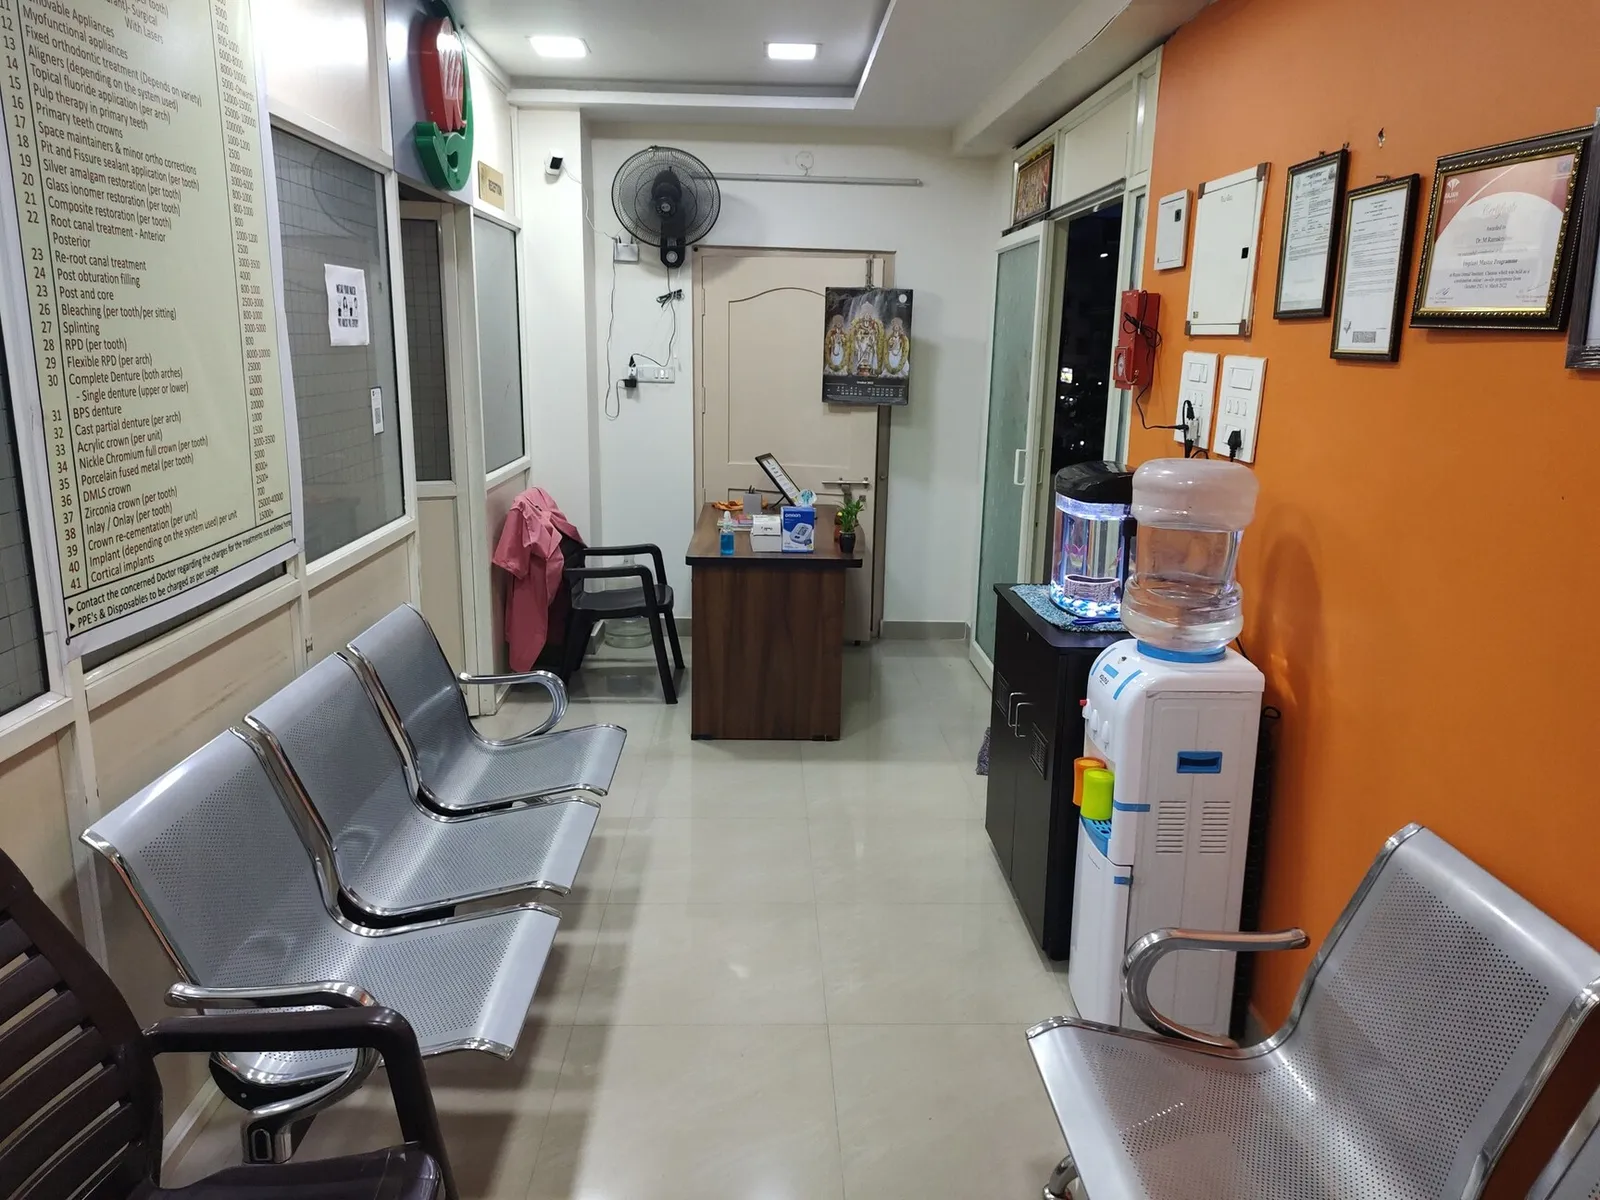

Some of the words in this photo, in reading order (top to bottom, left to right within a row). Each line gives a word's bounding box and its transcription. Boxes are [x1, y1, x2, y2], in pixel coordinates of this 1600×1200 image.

[72, 9, 115, 38] Appliances
[132, 4, 158, 26] Surgical
[22, 5, 87, 43] Myofunctional
[88, 35, 129, 60] appliances
[124, 16, 142, 34] With
[143, 25, 164, 44] Lasers
[0, 12, 14, 32] 12
[25, 24, 50, 45] Fixed
[51, 38, 102, 66] orthodontic
[102, 56, 140, 81] treatment
[4, 35, 16, 51] 13
[28, 44, 65, 69] Aligners
[6, 55, 19, 71] 14
[31, 62, 63, 86] Topical
[63, 74, 97, 97] fluoride
[98, 89, 139, 111] application
[9, 75, 22, 90] 15
[33, 82, 54, 103] Pulp
[55, 90, 89, 114] therapy
[99, 107, 129, 127] primary
[129, 115, 148, 130] teeth
[12, 94, 25, 110] 16
[35, 101, 71, 126] Primary
[72, 114, 95, 130] teeth
[96, 122, 124, 139] crowns
[14, 114, 26, 129] 17
[38, 120, 65, 140] Space
[66, 131, 114, 153] maintainers
[16, 133, 30, 149] 18
[40, 139, 55, 155] Pit
[56, 146, 72, 159] and
[73, 147, 102, 166] Fissure
[103, 158, 131, 173] sealant
[19, 153, 32, 168] 19
[43, 158, 68, 175] Silver
[69, 167, 107, 184] amalgam
[22, 171, 35, 187] 20
[45, 176, 70, 193] Glass
[70, 184, 105, 200] ionomer
[24, 191, 38, 206] 21
[48, 195, 94, 215] Composite
[95, 206, 136, 222] restoration
[26, 209, 40, 224] 22
[50, 213, 72, 229] Root
[73, 219, 95, 232] canal
[96, 222, 134, 238] treatment
[139, 228, 166, 242] Anterior
[52, 231, 91, 248] Posterior
[31, 247, 44, 261] 23
[55, 250, 88, 266] Re-root
[88, 255, 110, 267] canal
[110, 257, 147, 271] treatment
[33, 266, 46, 279] 24
[57, 267, 77, 281] Post
[78, 269, 120, 284] obturation
[120, 272, 141, 289] filling
[36, 284, 49, 298] 23
[59, 285, 79, 299] Post
[80, 287, 96, 300] and
[97, 291, 114, 301] core
[38, 302, 51, 316] 26
[61, 303, 102, 320] Bleaching
[103, 304, 119, 319] (per
[120, 306, 154, 320] tooth/per
[41, 320, 52, 334] 27
[62, 320, 101, 337] Splinting
[43, 338, 55, 352] 28
[65, 338, 84, 351] RPD
[85, 338, 103, 353] (per
[103, 338, 128, 352] tooth)
[45, 356, 57, 370] 29
[66, 355, 100, 368] Flexible
[101, 354, 117, 367] RPD
[118, 354, 134, 369] (per
[135, 353, 153, 367] arch)
[47, 374, 59, 387] 30
[68, 371, 109, 387] Complete
[110, 371, 141, 383] Denture
[141, 368, 160, 382] (both
[160, 367, 183, 379] arches)
[81, 388, 106, 404] Single
[107, 387, 137, 400] denture
[138, 384, 161, 398] (upper
[169, 381, 189, 393] lower)
[52, 409, 62, 422] 31
[73, 406, 91, 420] BPS
[91, 405, 122, 418] denture
[54, 426, 65, 440] 32
[74, 423, 94, 436] Cast
[95, 419, 121, 436] partial
[121, 418, 150, 430] denture
[55, 443, 66, 457] 33
[77, 438, 105, 454] Acrylic
[106, 436, 130, 449] crown
[57, 461, 68, 474] 34
[79, 454, 105, 469] Nickle
[105, 449, 145, 465] Chromium
[59, 477, 70, 491] 35
[81, 469, 118, 486] Porcelain
[119, 464, 140, 478] fused
[140, 459, 161, 474] metal
[61, 494, 73, 508] 36
[83, 486, 107, 503] DMLS
[107, 484, 132, 497] crown
[63, 510, 74, 525] 37
[84, 503, 117, 520] Zirconia
[117, 497, 141, 511] crown
[64, 527, 77, 541] 38
[86, 521, 106, 535] Inlay
[112, 513, 135, 528] Onlay
[66, 544, 78, 558] 39
[88, 536, 115, 551] Crown
[115, 520, 170, 543] re-cementation
[170, 515, 184, 529] (per
[184, 509, 198, 523] unit)
[68, 560, 80, 573] 40
[89, 548, 121, 567] Implant
[122, 537, 163, 559] (depending
[70, 577, 82, 590] 41
[90, 562, 123, 583] Cortical
[123, 554, 156, 572] implants
[76, 593, 106, 612] Contact
[106, 589, 120, 601] the
[120, 573, 156, 596] concerned
[156, 568, 177, 583] Doctor
[78, 612, 98, 628] PPE's
[99, 608, 107, 620] &
[107, 594, 149, 617] Disposables
[149, 591, 157, 600] to
